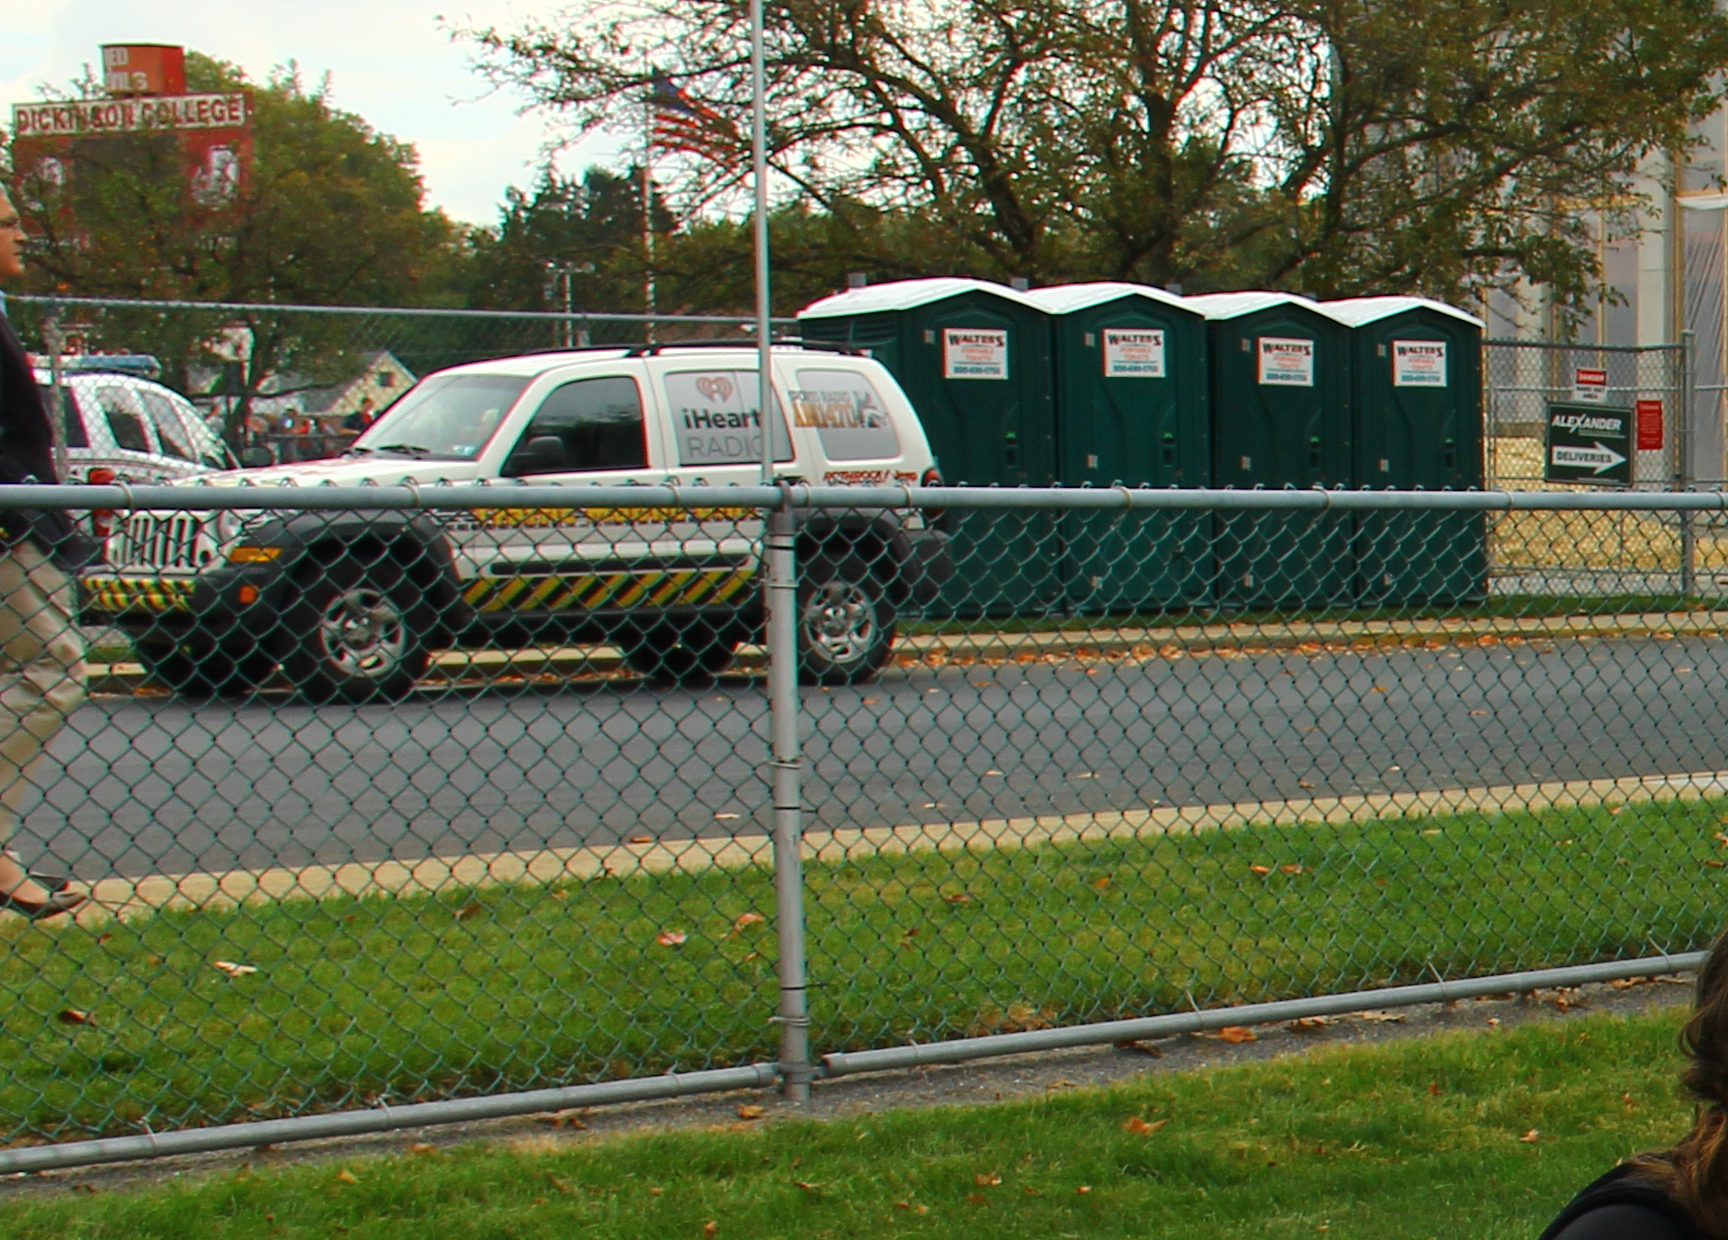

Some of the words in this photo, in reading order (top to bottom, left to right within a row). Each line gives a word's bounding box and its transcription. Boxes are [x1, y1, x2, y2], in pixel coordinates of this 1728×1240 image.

[142, 98, 245, 126] COLLEGE
[683, 408, 761, 428] iHeart
[1552, 414, 1622, 433] ALEXANDER
[1556, 451, 1612, 462] DELIVERIES
